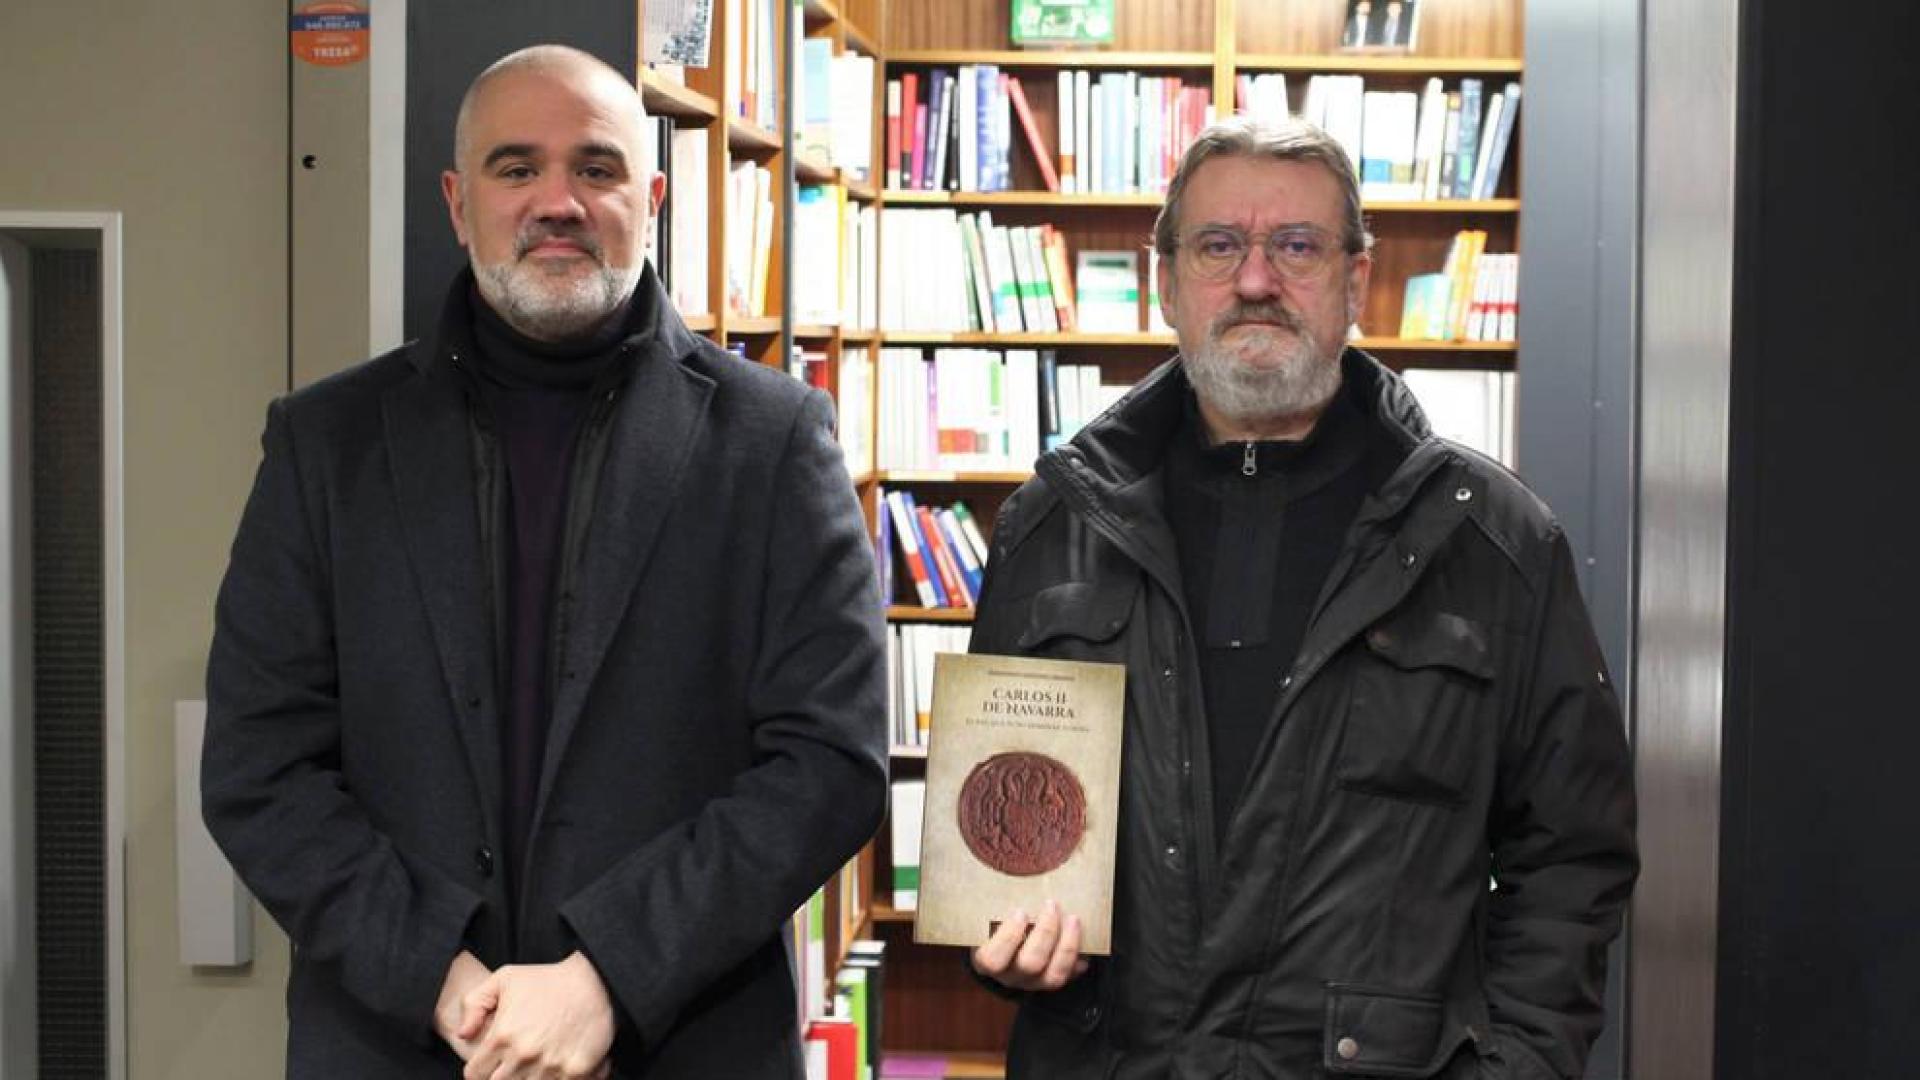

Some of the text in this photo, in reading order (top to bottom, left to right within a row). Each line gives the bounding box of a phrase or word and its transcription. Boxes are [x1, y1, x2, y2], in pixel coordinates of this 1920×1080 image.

[992, 688, 1052, 703] CARLOS
[983, 701, 1075, 718] DE NAVARRA
